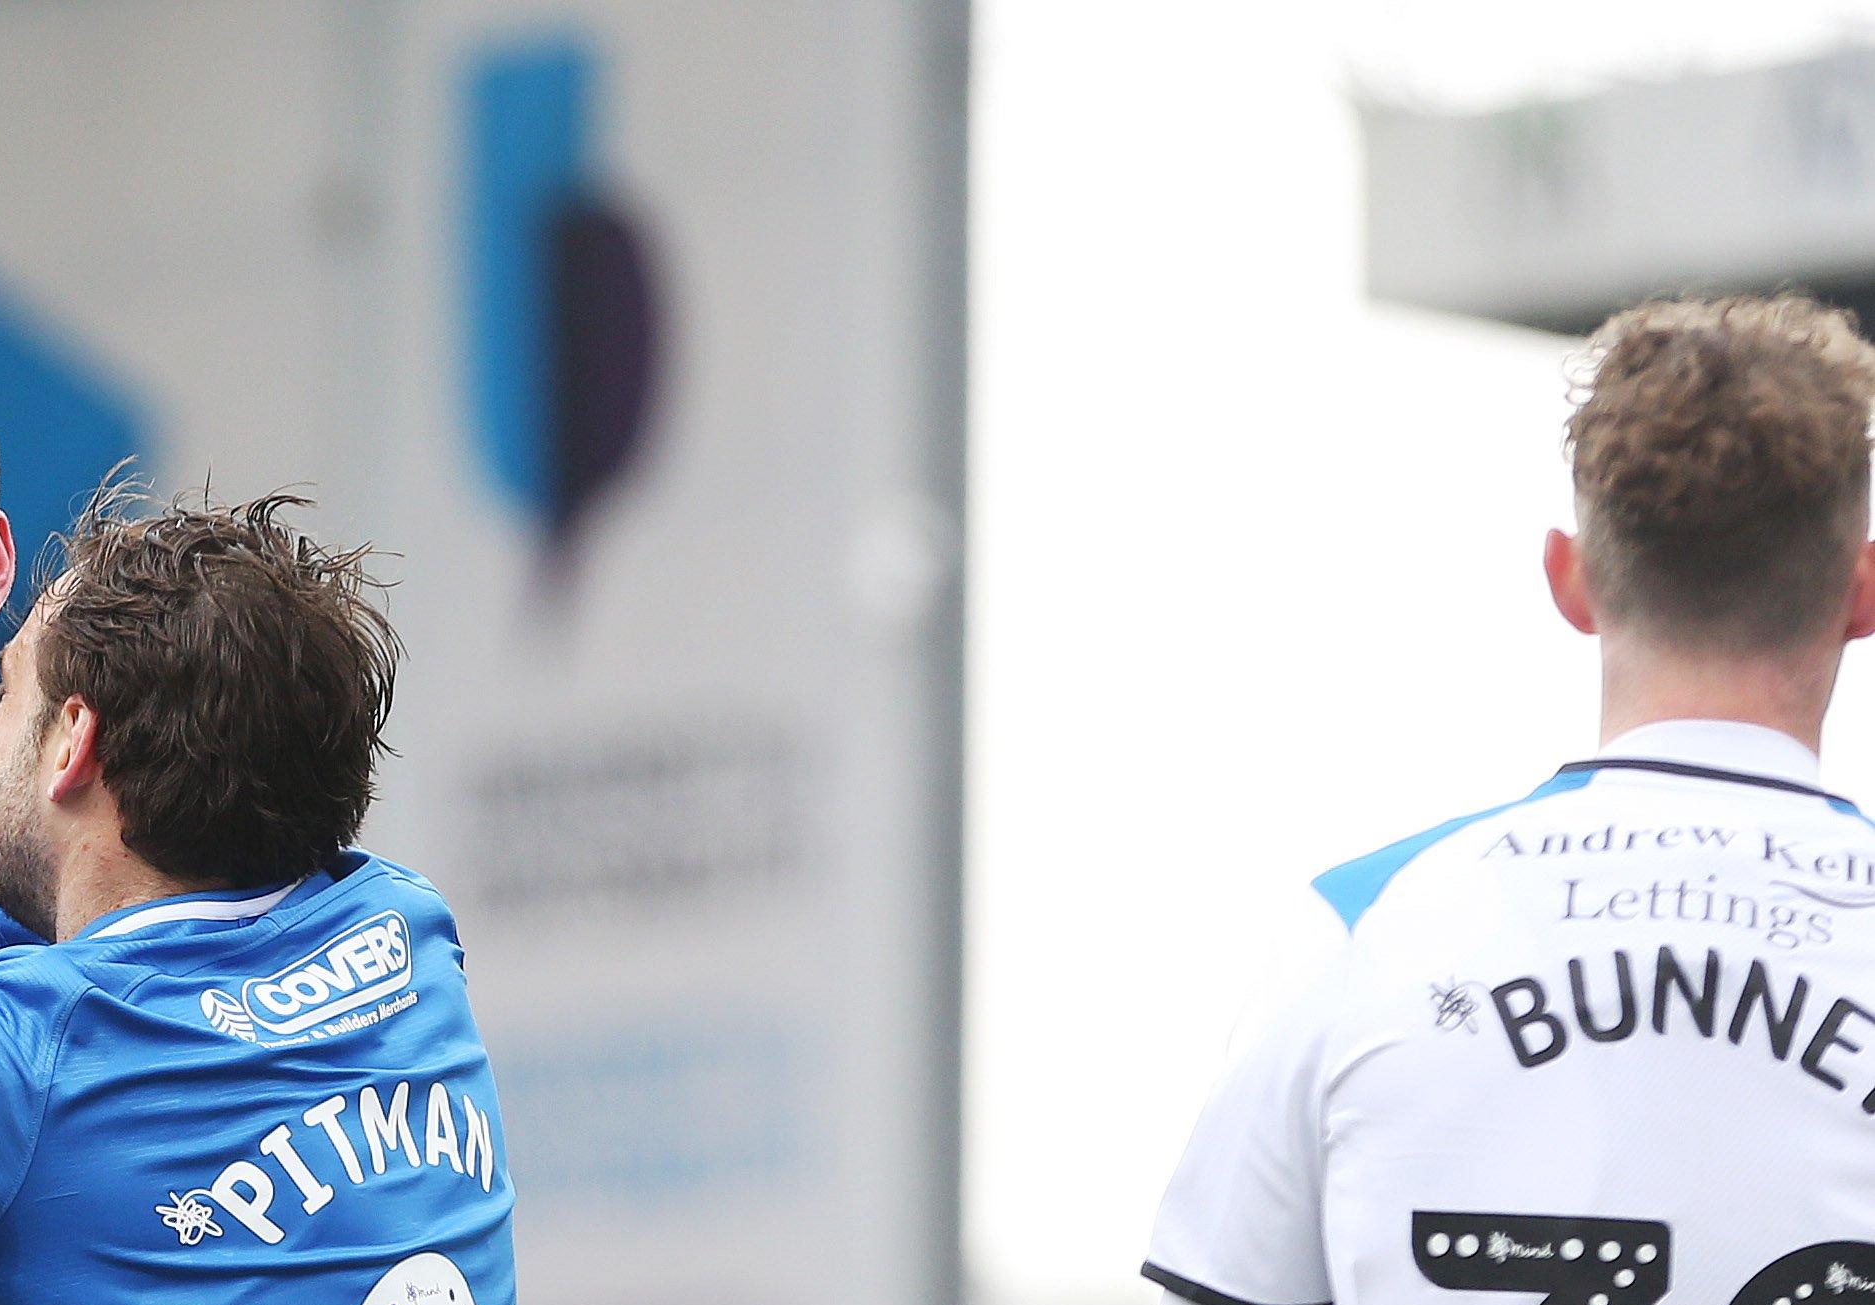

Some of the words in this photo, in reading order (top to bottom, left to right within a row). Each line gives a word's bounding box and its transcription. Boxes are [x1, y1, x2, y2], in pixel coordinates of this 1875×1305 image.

[1480, 824, 1737, 860] Andrew
[1562, 875, 1835, 950] Lettings
[253, 919, 407, 1016] COVERS
[324, 1010, 379, 1037] Builders
[377, 990, 418, 1021] Merchants
[1491, 944, 1875, 1114] BUNNE
[210, 1081, 494, 1244] PITMAN
